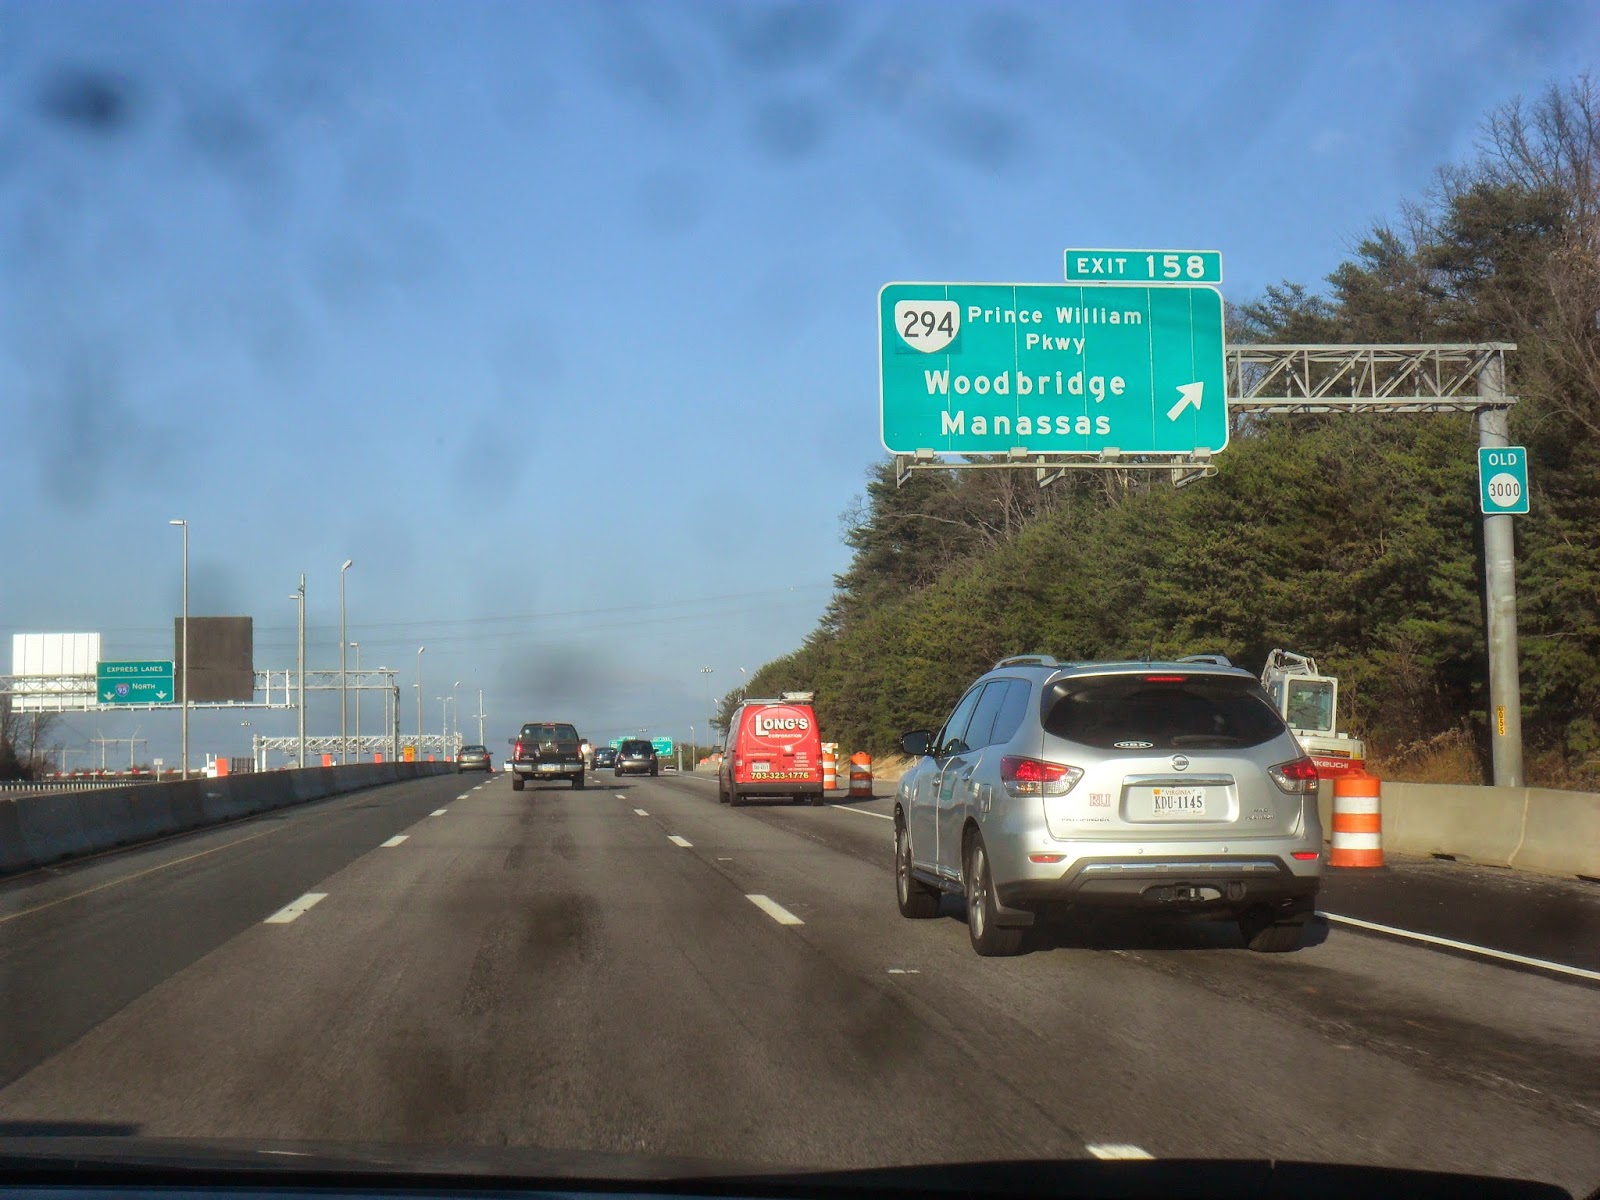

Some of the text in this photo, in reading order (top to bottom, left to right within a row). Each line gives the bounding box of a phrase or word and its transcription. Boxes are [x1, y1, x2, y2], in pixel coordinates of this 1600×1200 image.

[1076, 254, 1205, 278] EXIT 158
[903, 310, 954, 338] 294
[968, 306, 1142, 324] Prince William
[1026, 333, 1086, 355] Pkwy
[924, 370, 1126, 403] Woodbridge
[940, 410, 1111, 435] Manassas
[1488, 452, 1517, 466] OLD
[1489, 482, 1520, 497] 3000
[755, 714, 809, 736] LONG'S
[1089, 793, 1111, 807] RU
[1154, 795, 1203, 809] KDU-1145
